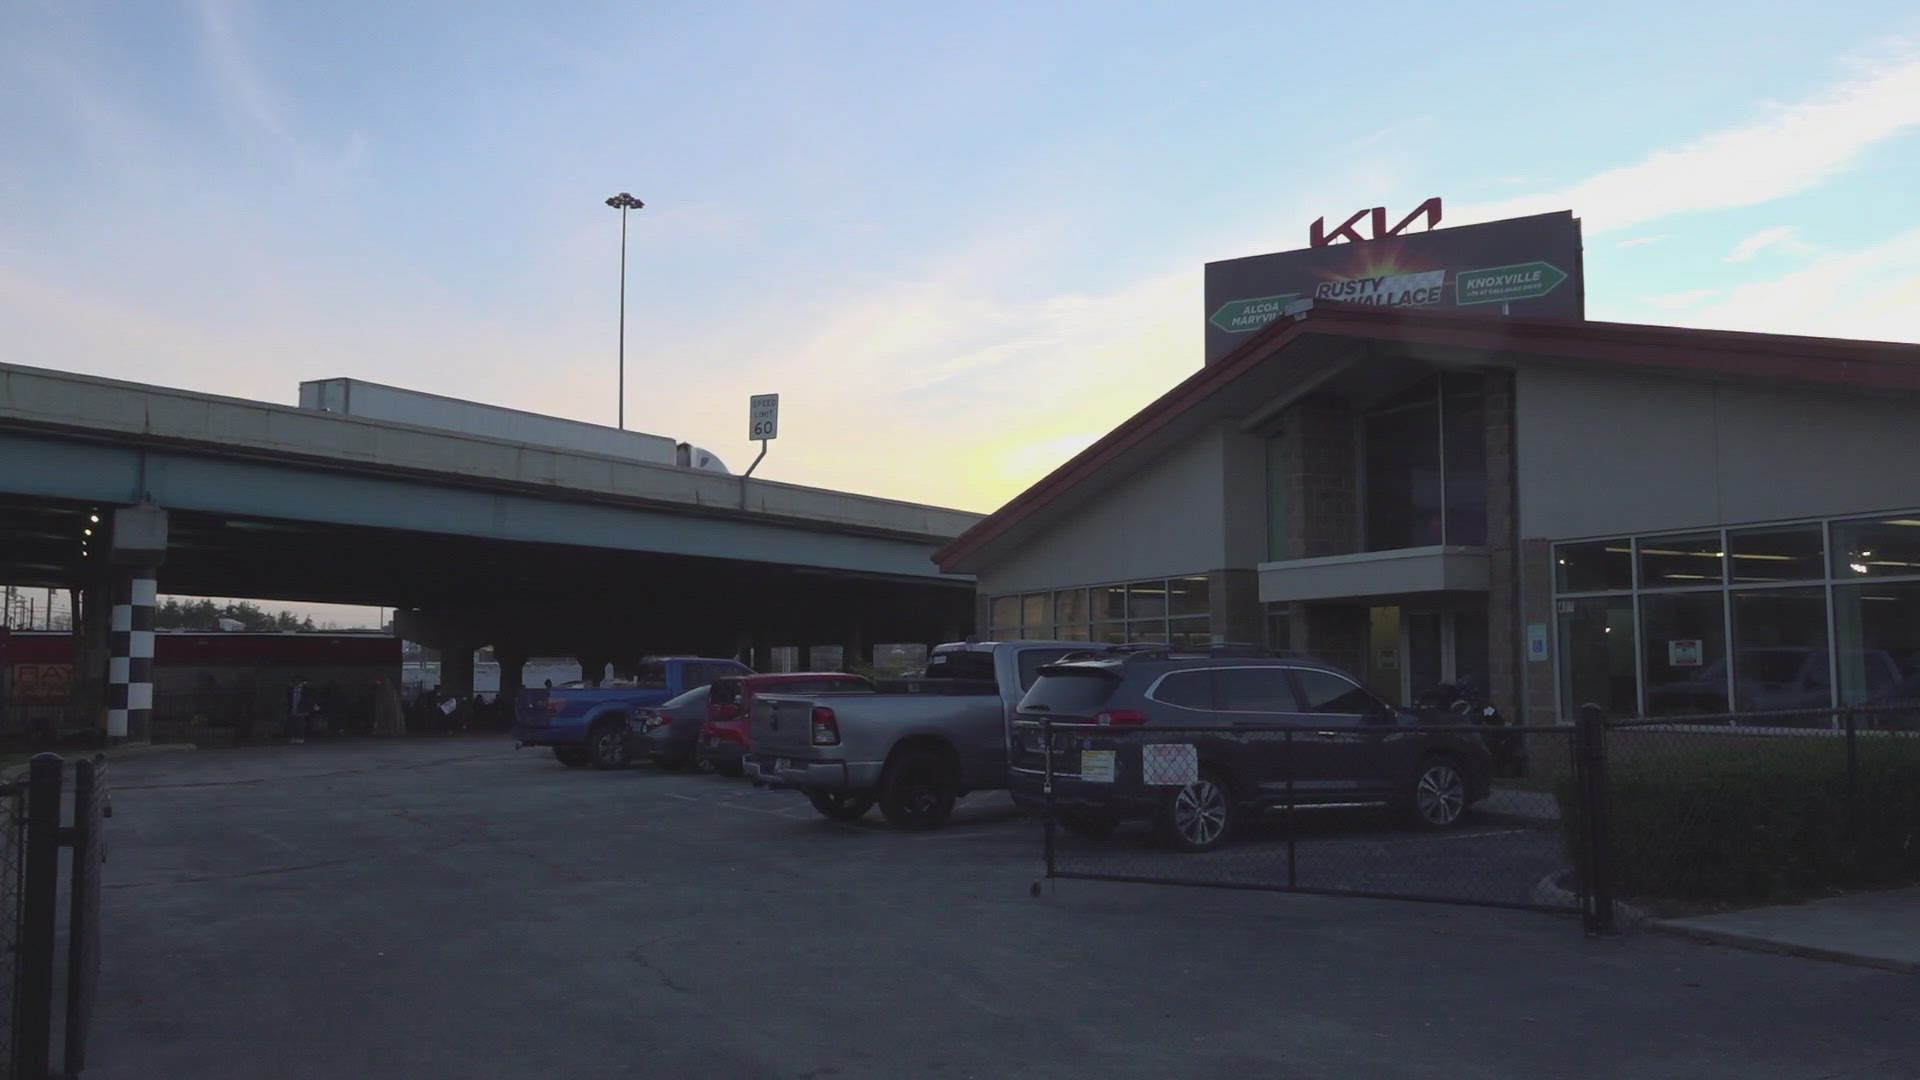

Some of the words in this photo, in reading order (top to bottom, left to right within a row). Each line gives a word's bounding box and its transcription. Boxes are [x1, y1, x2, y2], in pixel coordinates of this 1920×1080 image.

[1310, 197, 1442, 249] KIA
[1466, 270, 1543, 289] KNOXVILLE
[1318, 276, 1384, 299] RUSTY
[1243, 302, 1279, 315] ALCOA
[1231, 313, 1279, 327] MARYVIL
[752, 399, 776, 408] SPEED
[754, 420, 773, 435] 60
